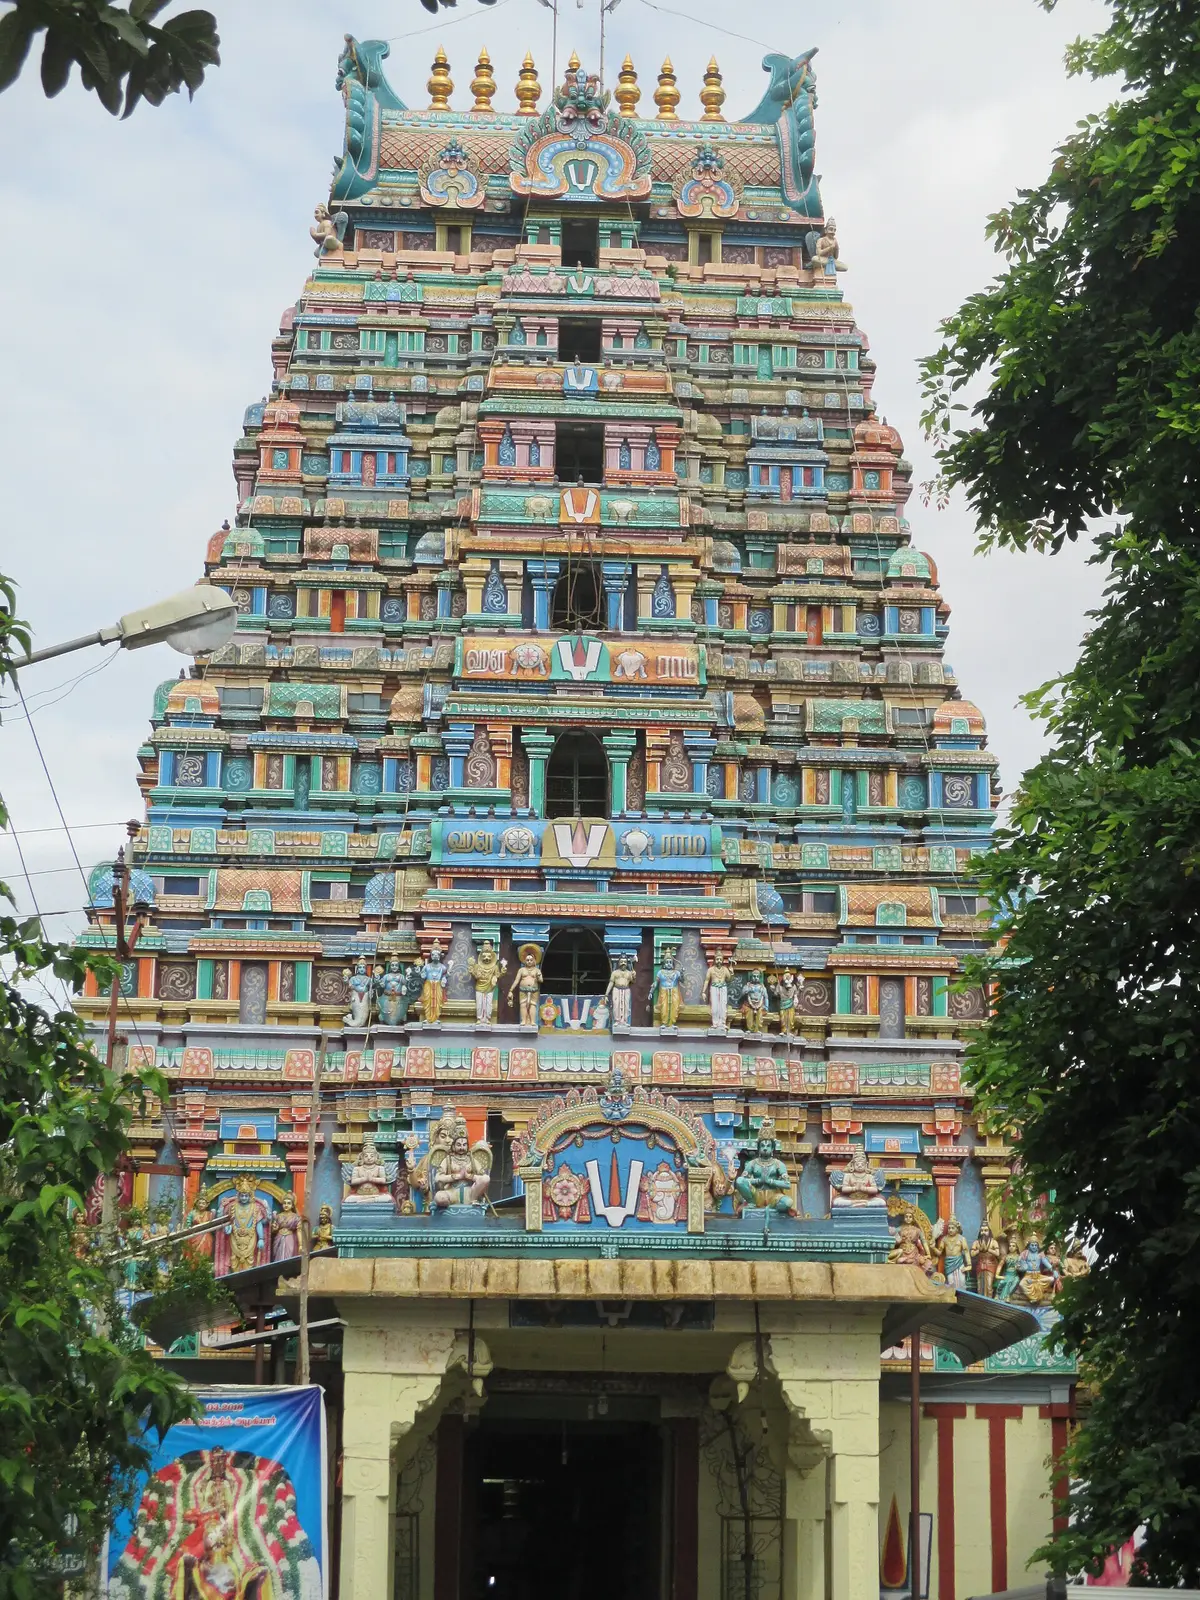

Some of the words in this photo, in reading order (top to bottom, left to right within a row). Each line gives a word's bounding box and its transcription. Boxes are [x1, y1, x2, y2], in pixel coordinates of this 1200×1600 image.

[466, 649, 507, 674] ஹரே
[448, 830, 493, 855] ஹரே
[661, 834, 706, 857] ராம
